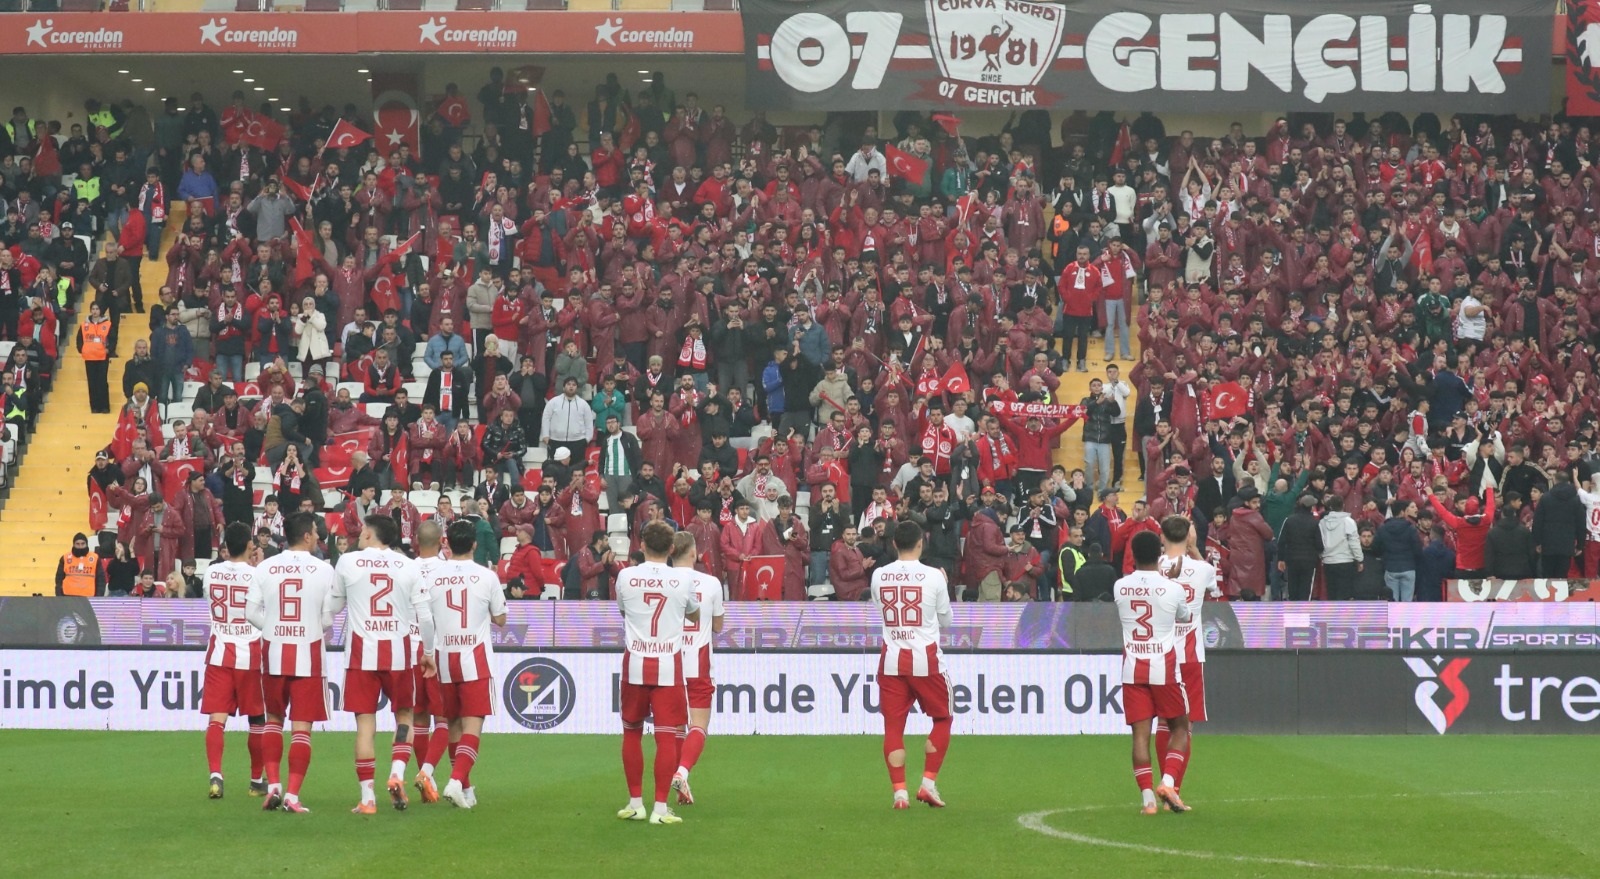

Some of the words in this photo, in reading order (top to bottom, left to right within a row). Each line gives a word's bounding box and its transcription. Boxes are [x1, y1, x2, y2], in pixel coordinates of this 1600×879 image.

[1005, 1, 1056, 21] NORD
[50, 27, 124, 43] corendon
[223, 27, 297, 43] corendon
[443, 26, 517, 42] corendon
[619, 27, 693, 43] corendon
[771, 11, 903, 93] 07
[1085, 4, 1507, 103] GENÇLİK
[951, 31, 976, 60] 19
[1005, 37, 1038, 66] 81
[938, 81, 959, 98] 07
[964, 86, 1037, 107] GENÇLİK
[1010, 402, 1025, 412] 07
[269, 565, 301, 575] anex
[355, 558, 390, 568] anex
[210, 571, 237, 581] anex
[434, 575, 465, 586] anex
[629, 578, 664, 588] anex
[881, 572, 910, 582] anex
[369, 573, 394, 617] 2
[1120, 586, 1150, 596] anex
[209, 583, 249, 624] 85
[279, 578, 303, 622] 6
[445, 587, 467, 629] 4
[879, 586, 923, 627] 88
[643, 592, 668, 637] 7
[1130, 600, 1154, 641] 3
[274, 625, 306, 637] SONER
[364, 620, 399, 632] SAMET
[3, 669, 115, 710] imde
[1494, 663, 1600, 722] tre
